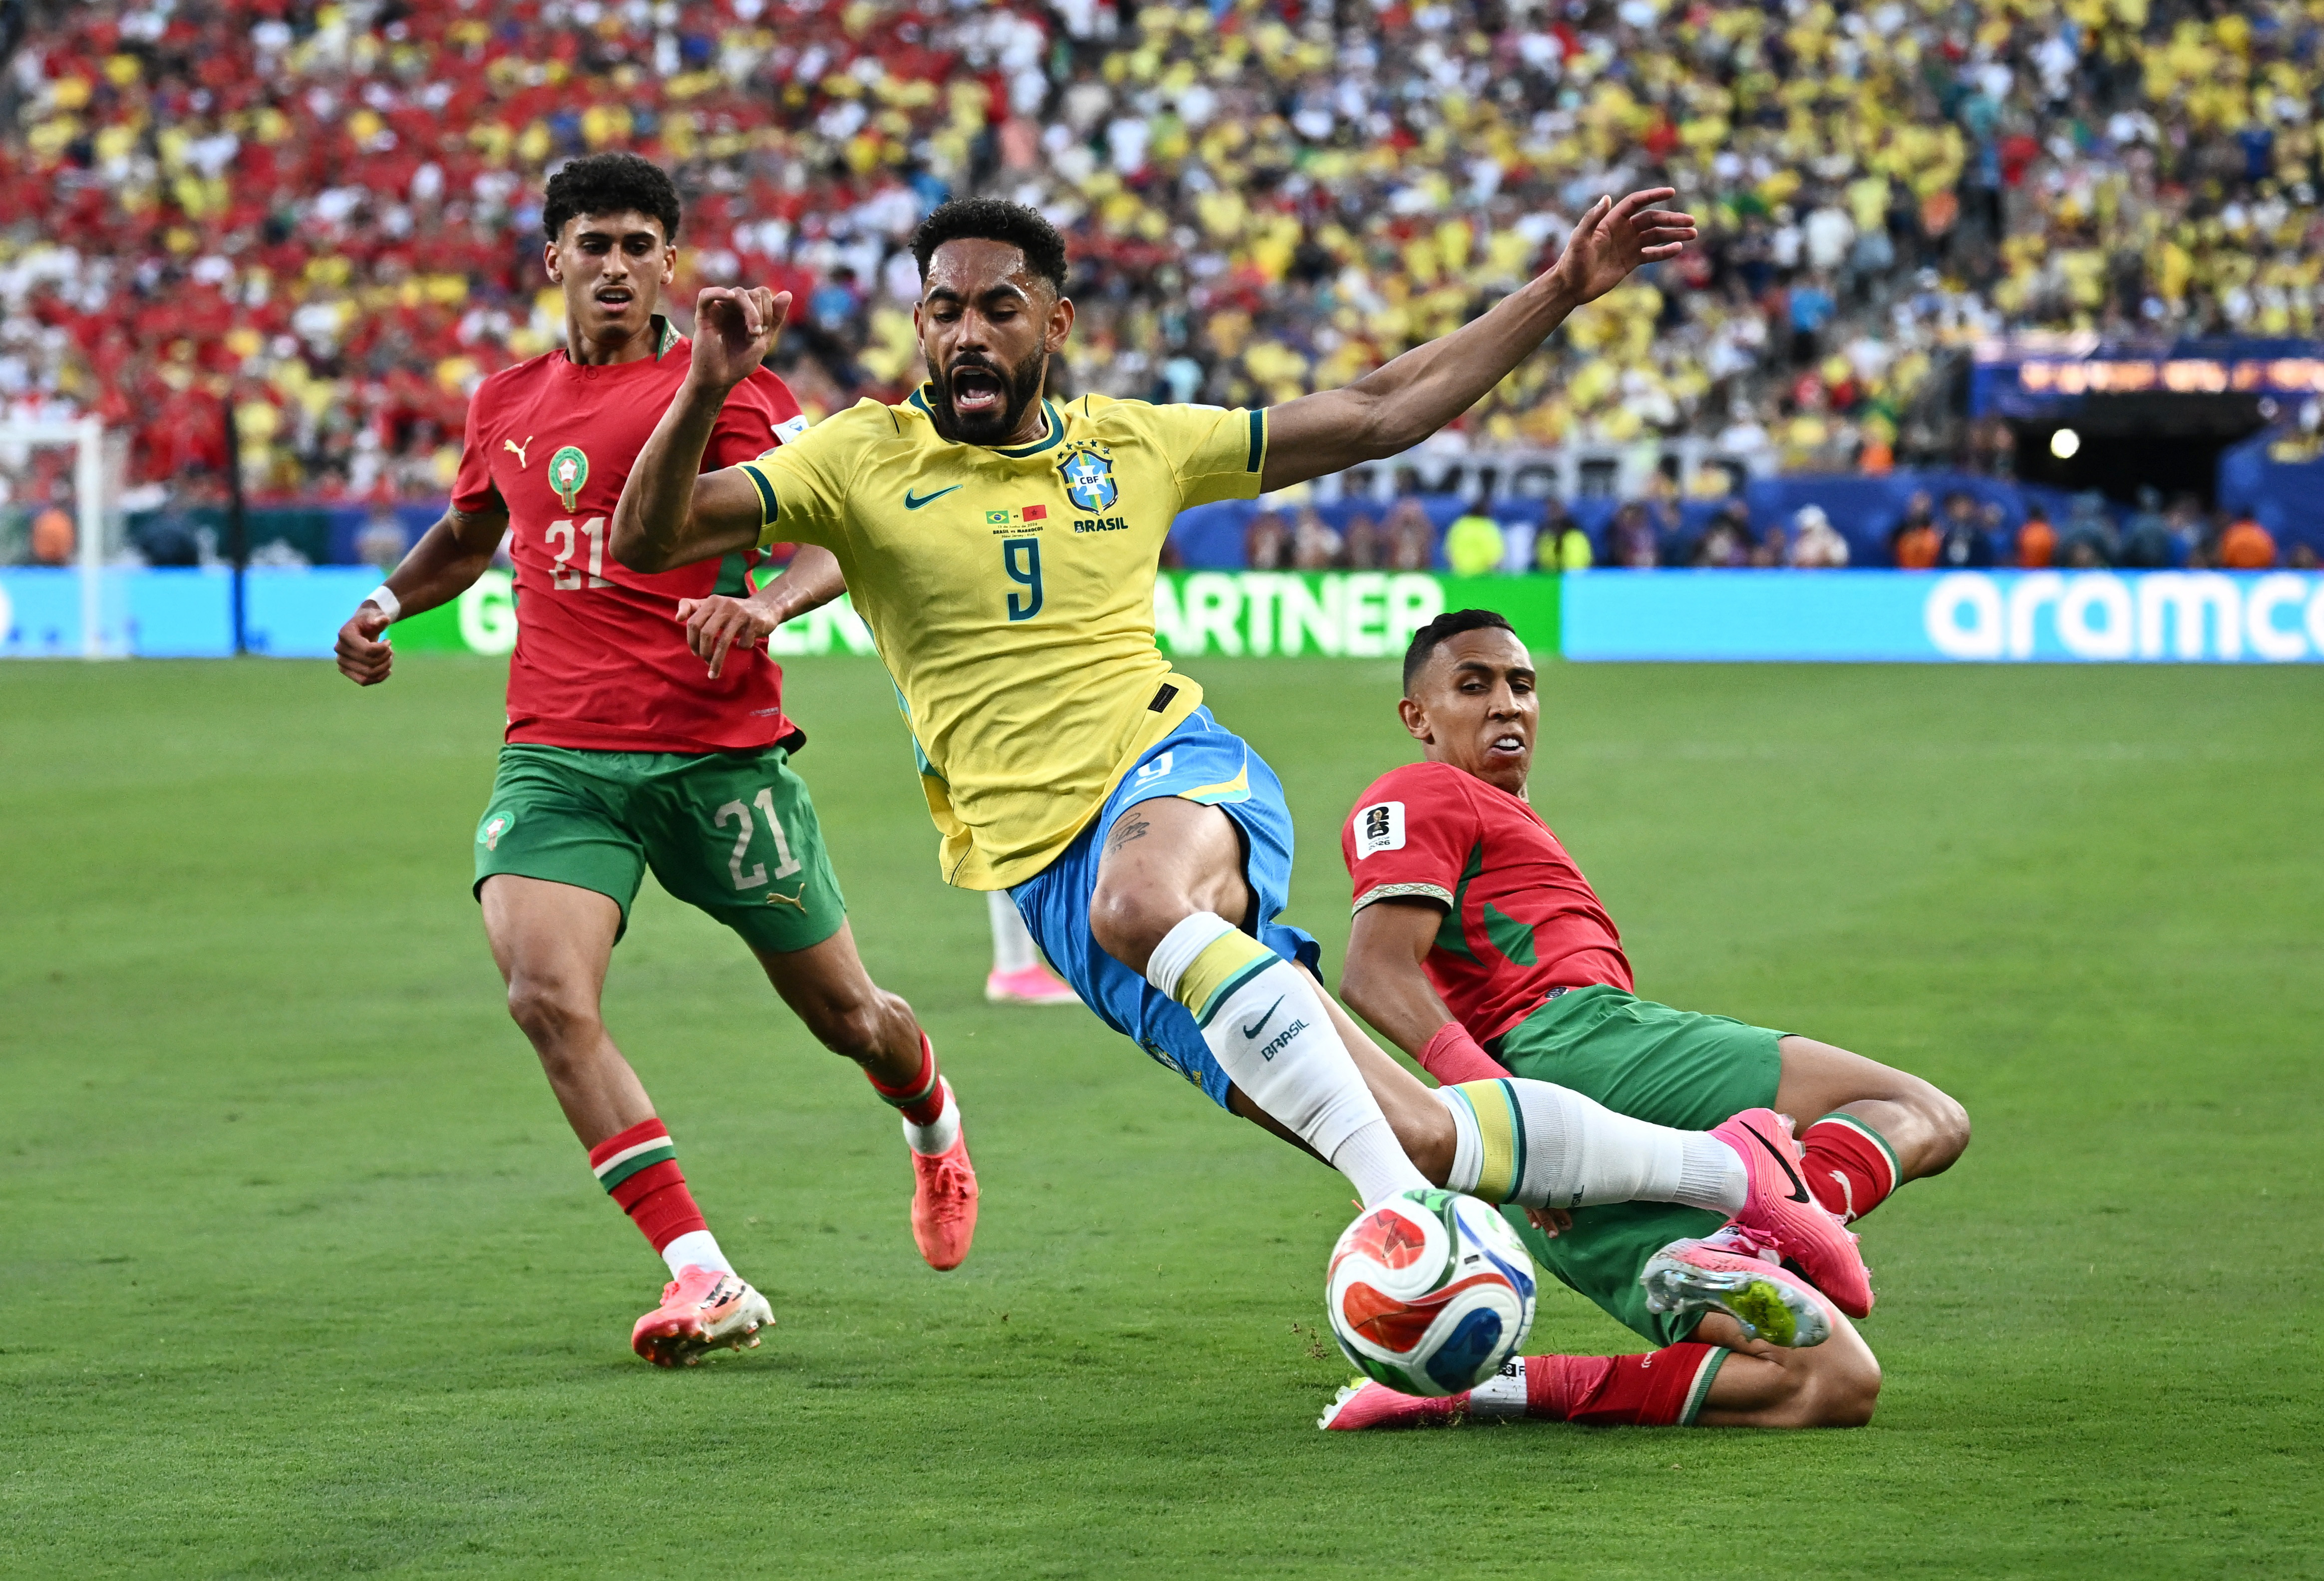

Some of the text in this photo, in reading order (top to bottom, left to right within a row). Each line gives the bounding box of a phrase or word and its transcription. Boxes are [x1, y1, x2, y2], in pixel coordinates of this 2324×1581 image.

[1080, 476, 1099, 484] CBF
[545, 517, 617, 590] 21
[1074, 517, 1128, 533] BRASIL
[1003, 537, 1044, 622] 9
[1153, 571, 1446, 657] ARTNER
[1134, 751, 1174, 787] 9
[714, 787, 801, 891] 21
[1261, 1019, 1310, 1062] BRASIL
